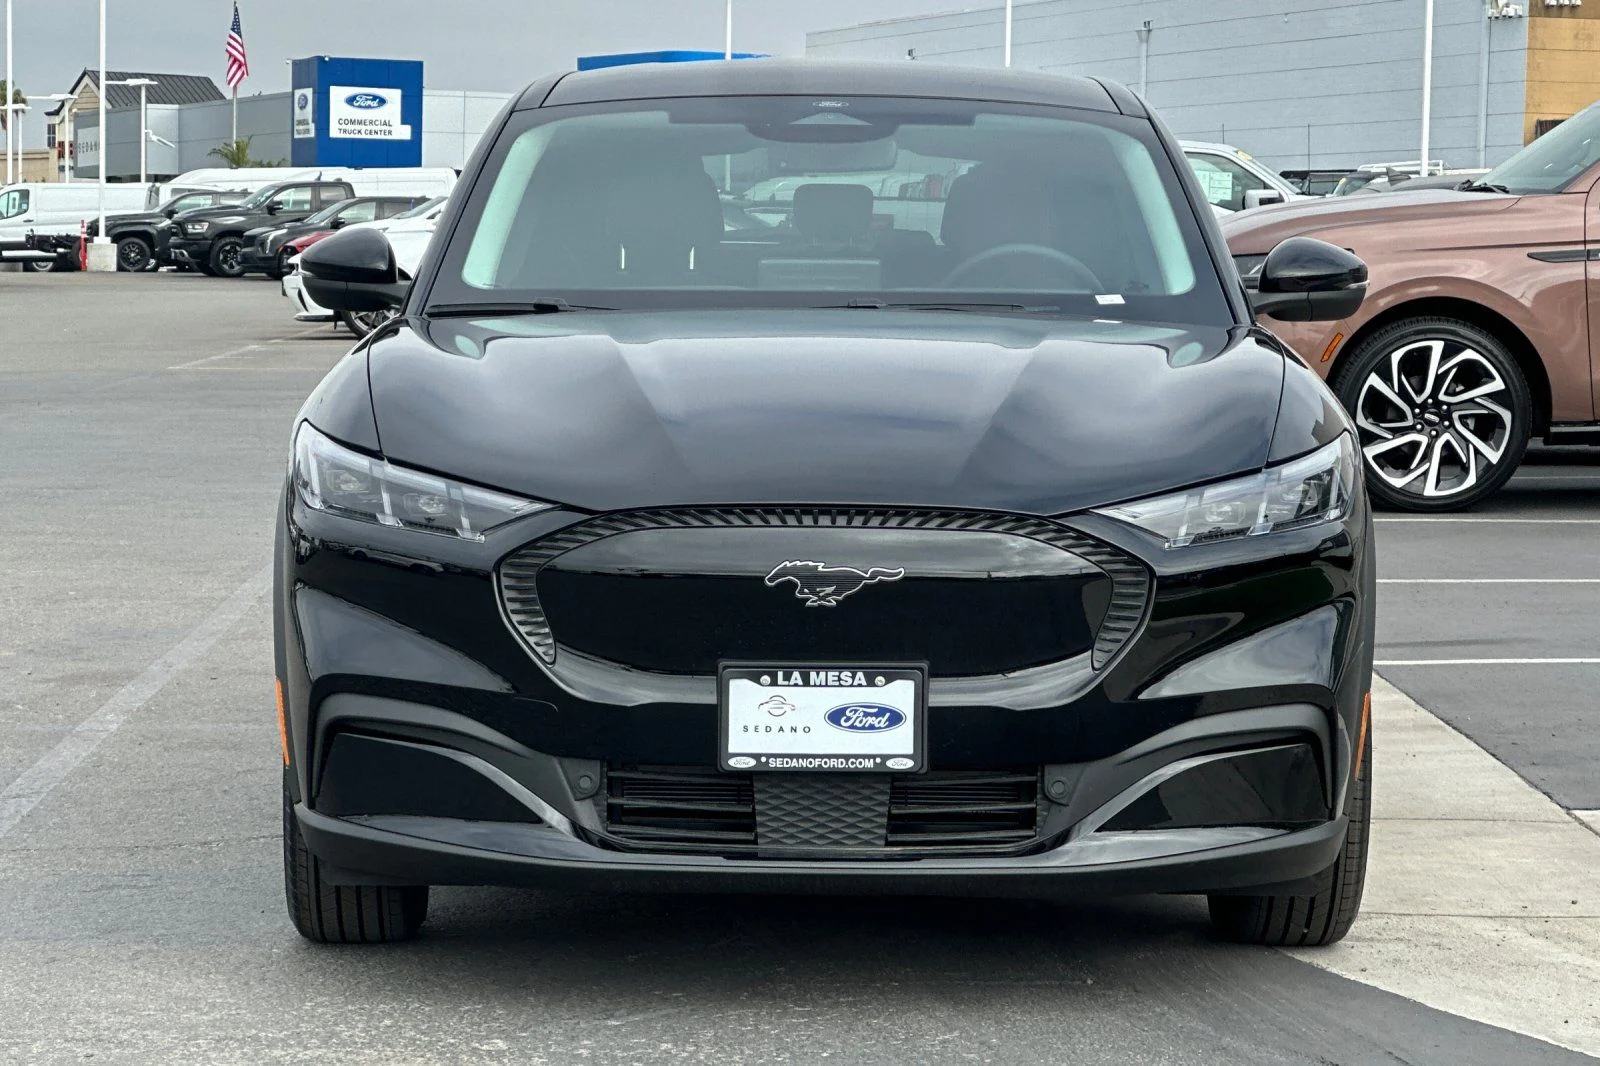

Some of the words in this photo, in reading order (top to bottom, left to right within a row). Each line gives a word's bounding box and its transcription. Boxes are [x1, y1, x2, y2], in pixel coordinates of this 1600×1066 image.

[353, 94, 380, 107] Ford
[337, 118, 393, 127] COMMERCIAL
[337, 128, 363, 136] TRUCK
[364, 129, 393, 137] CENTER
[777, 671, 804, 686] LA
[809, 671, 867, 686] MESA
[840, 706, 891, 728] Ford
[742, 725, 811, 733] SEDANO
[768, 757, 874, 769] SEDANOFORD.COM
